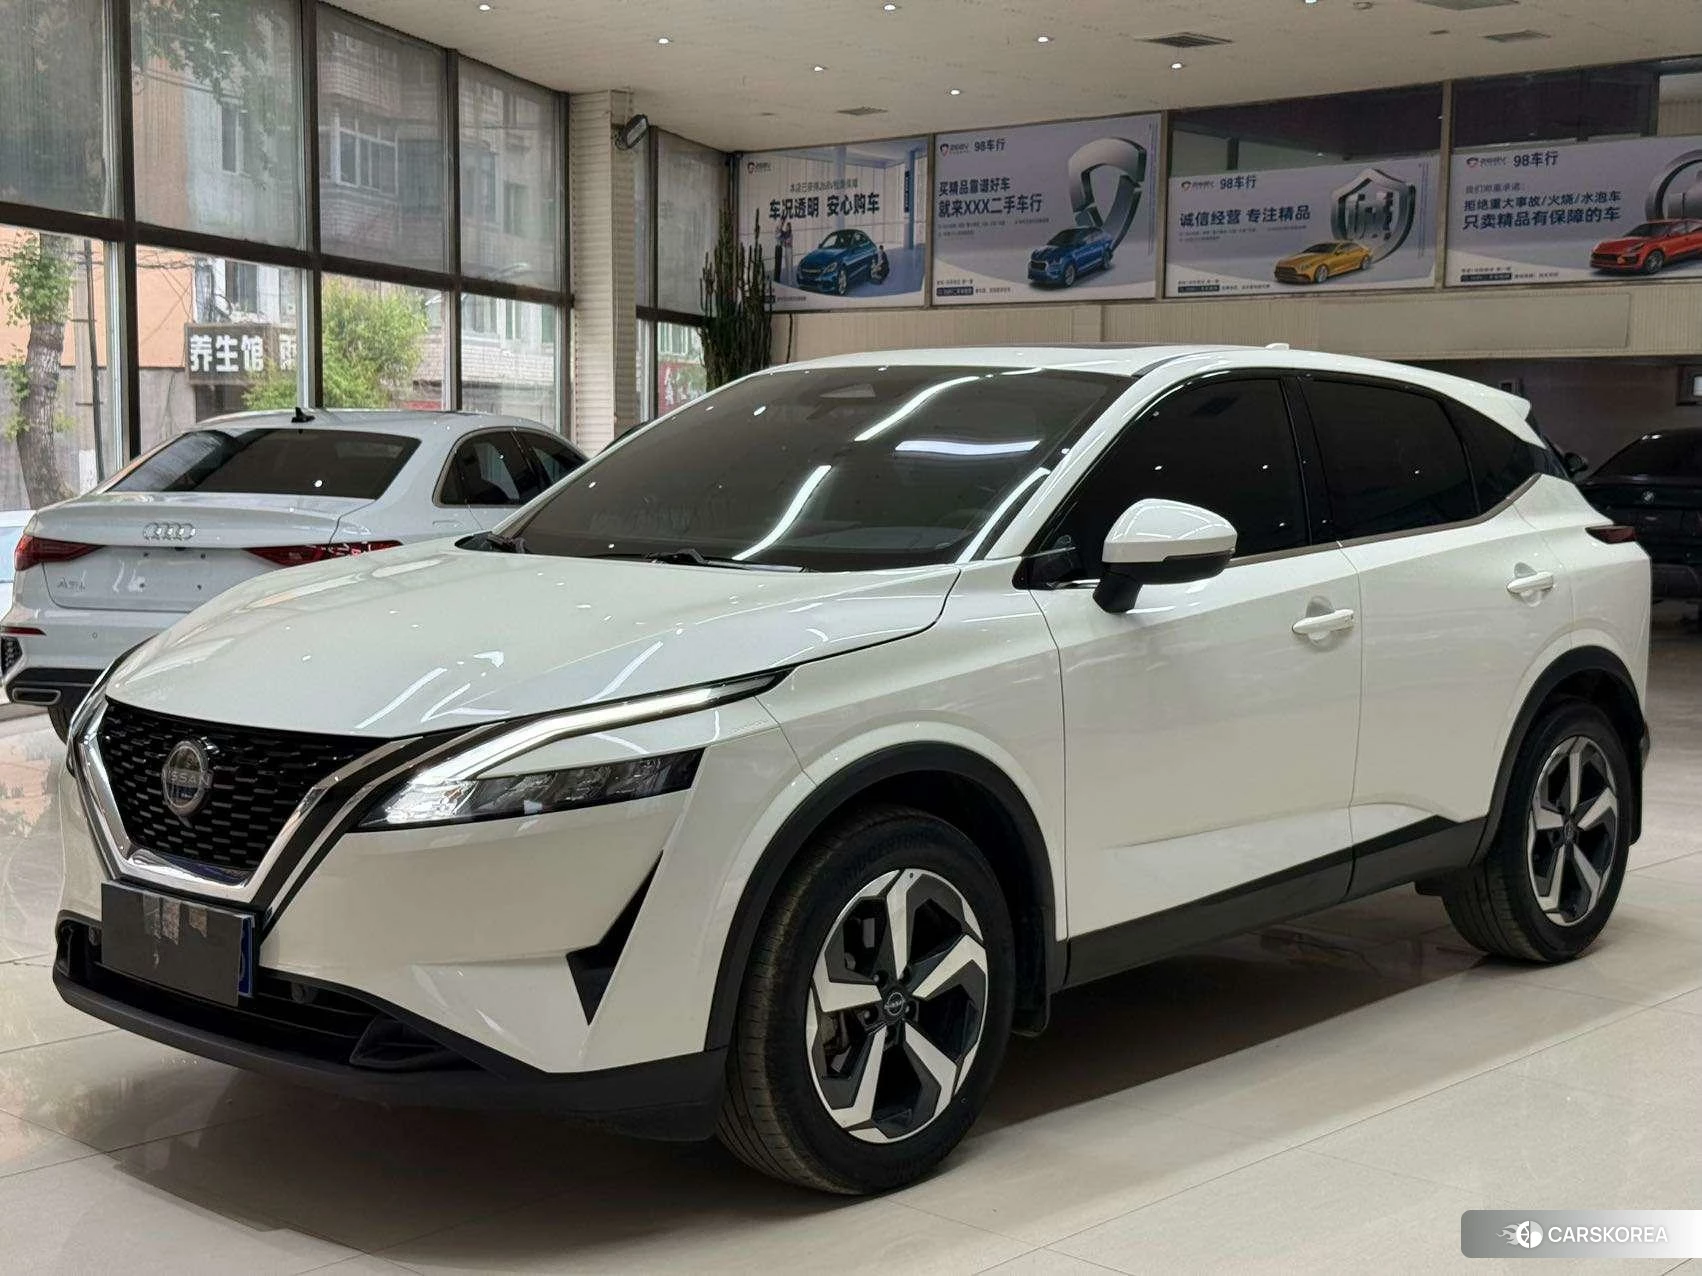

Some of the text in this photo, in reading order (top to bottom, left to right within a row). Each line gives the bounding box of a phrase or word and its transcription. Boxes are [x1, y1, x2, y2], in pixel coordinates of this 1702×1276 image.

[1513, 151, 1559, 168] 98车行
[1219, 175, 1256, 190] 98车行
[769, 192, 880, 221] 车况透明 安心购车
[1180, 204, 1311, 228] 诚信经营 专注精品
[1462, 206, 1621, 231] 只卖精品有保障的车
[190, 334, 264, 372] 养生馆
